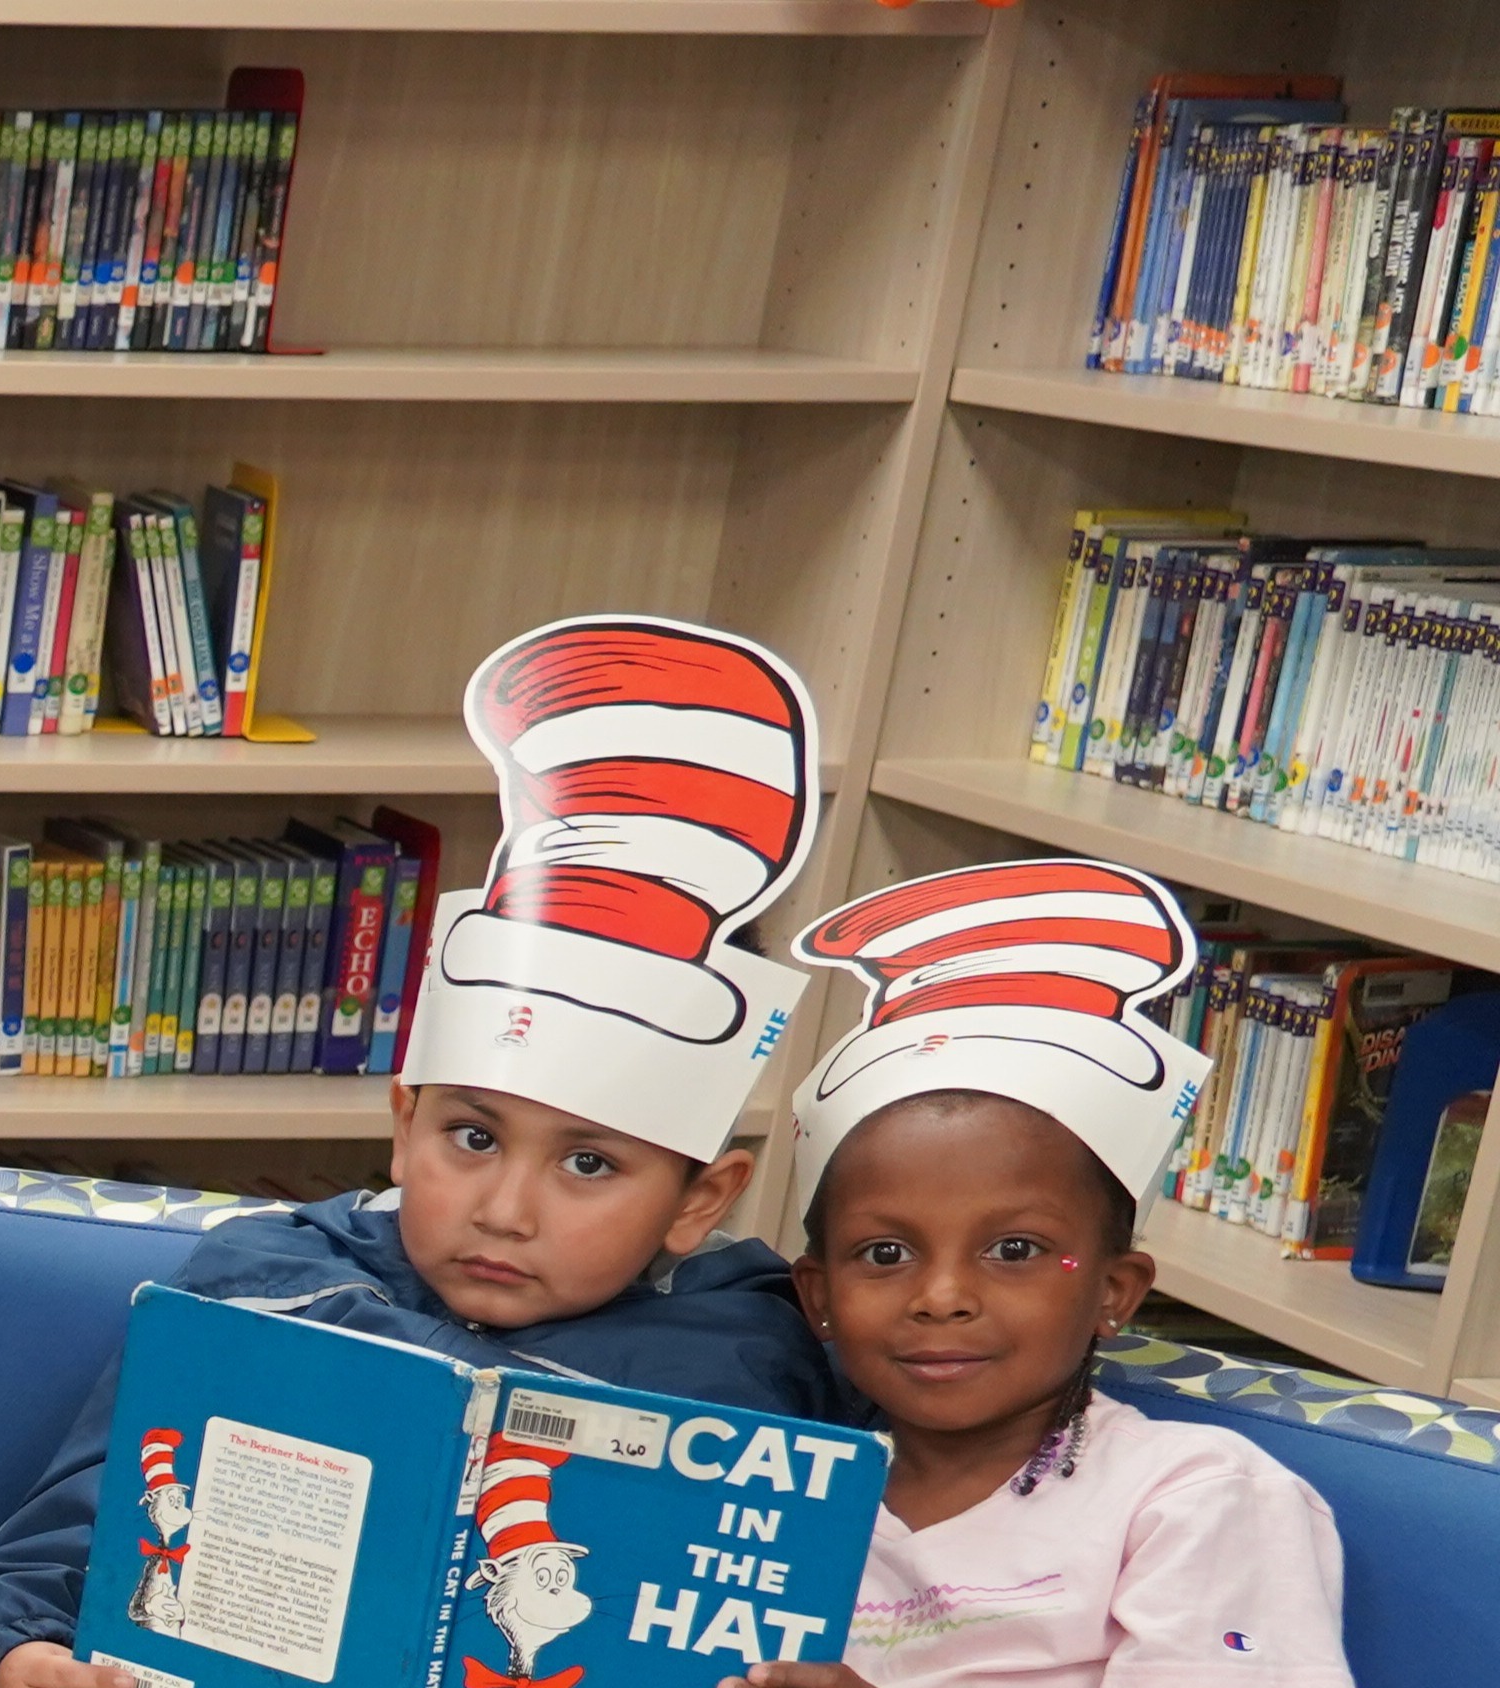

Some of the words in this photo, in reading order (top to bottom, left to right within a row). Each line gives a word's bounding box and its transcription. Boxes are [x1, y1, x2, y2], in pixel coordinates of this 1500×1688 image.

[346, 907, 378, 995] ECHO
[751, 1008, 790, 1060] THE
[611, 1438, 647, 1456] 260
[668, 1416, 857, 1500] CAT
[717, 1502, 783, 1542] IN
[451, 1529, 469, 1561] THE
[443, 1567, 461, 1598] CAT
[687, 1544, 791, 1595] THE
[438, 1603, 452, 1621] IN
[628, 1581, 827, 1664] HAT
[432, 1625, 449, 1653] THE
